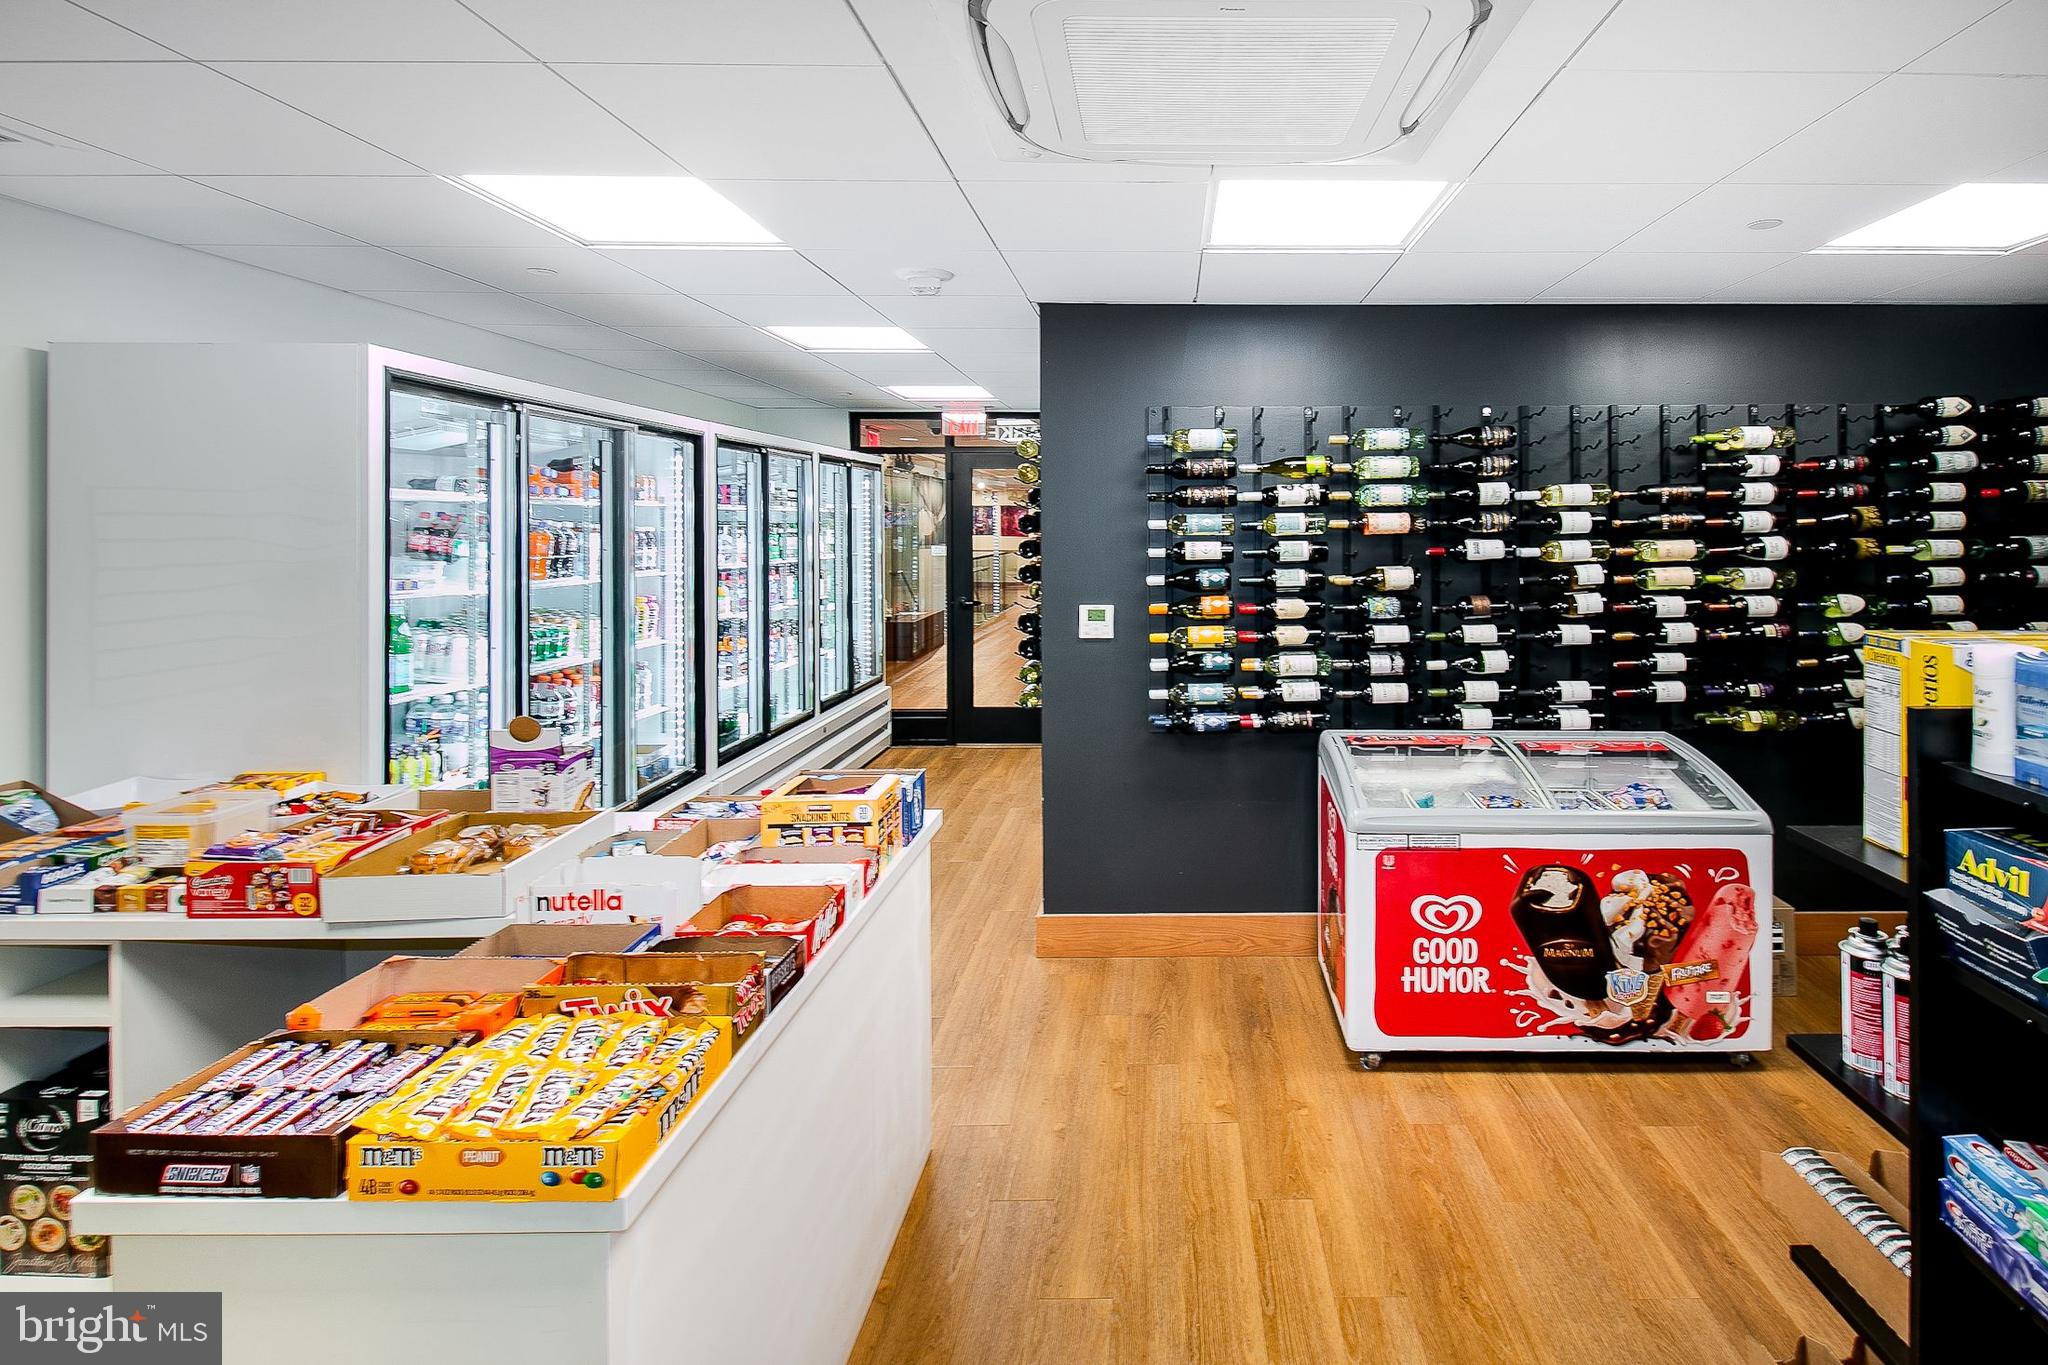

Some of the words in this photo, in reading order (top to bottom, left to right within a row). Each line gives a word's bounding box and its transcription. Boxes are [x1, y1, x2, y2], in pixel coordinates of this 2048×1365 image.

[1923, 655, 1940, 707] erios
[791, 813, 829, 822] SNACKING
[831, 813, 850, 821] NUTS
[1957, 849, 2031, 898] Advil
[537, 889, 623, 912] nutella
[1413, 937, 1479, 965] GOOD
[1543, 948, 1595, 958] MAGNUM
[1401, 967, 1492, 993] HUMOR
[1611, 971, 1645, 993] KING
[525, 989, 541, 999] 36
[359, 1146, 424, 1168] m&m's
[461, 1150, 502, 1164] PEANUT
[541, 1146, 605, 1168] m&m's
[167, 1166, 228, 1182] SNICKERS
[359, 1178, 377, 1195] 48
[1947, 1154, 2017, 1219] Crest
